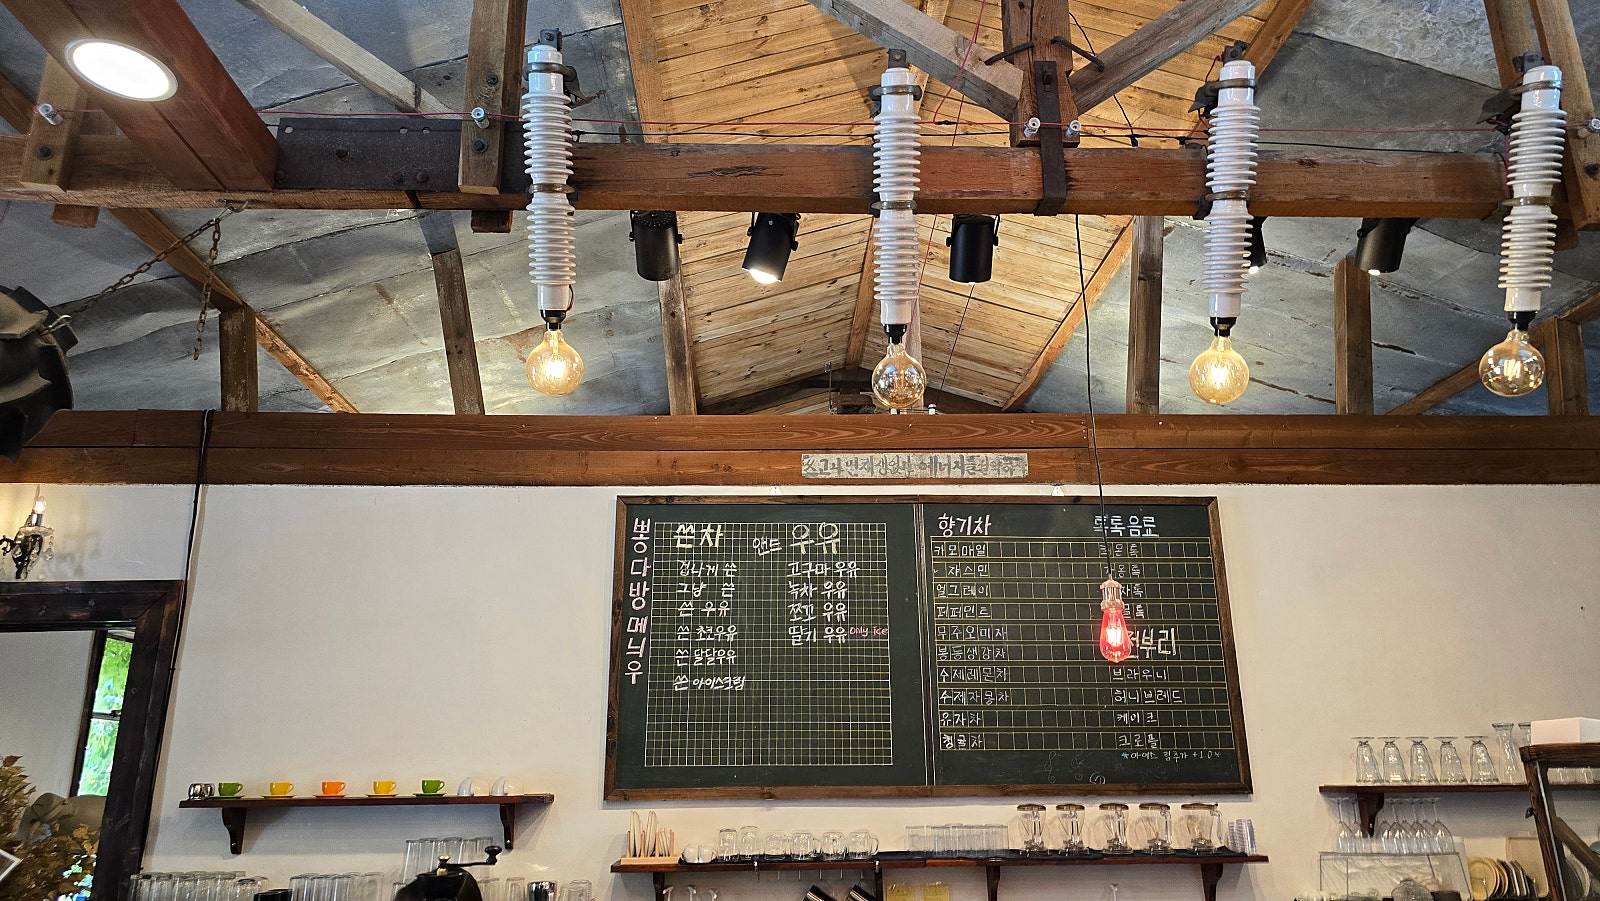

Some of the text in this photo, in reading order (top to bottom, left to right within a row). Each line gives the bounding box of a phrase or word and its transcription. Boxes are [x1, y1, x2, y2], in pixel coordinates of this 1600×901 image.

[938, 513, 992, 537] 향기차
[790, 522, 841, 554] 우유
[934, 544, 986, 557] 카모마일
[677, 560, 738, 578] 겁나게 쓴
[787, 561, 860, 578] 고구마 우유
[676, 581, 736, 598] 그냥 쓴
[788, 581, 848, 600] 녹차 우유
[936, 583, 989, 598] 얼그레이
[677, 600, 731, 618] 쓴 우유
[823, 602, 848, 622] 우유
[676, 625, 690, 641] 쓴
[788, 626, 848, 646] 딸기 우유
[938, 626, 1007, 640] 무주오미자
[675, 648, 737, 667] 쓴 달달우유
[673, 674, 745, 691] 쓴 아이스크림
[940, 667, 1008, 682] 수제레몬차
[1112, 668, 1167, 681] 브라우니
[940, 689, 1010, 705] 수제자몽차
[1114, 689, 1183, 703] 허니브레드
[940, 711, 981, 726] 유자차
[1117, 712, 1158, 725] 케이크
[1118, 734, 1159, 749] 크로플
